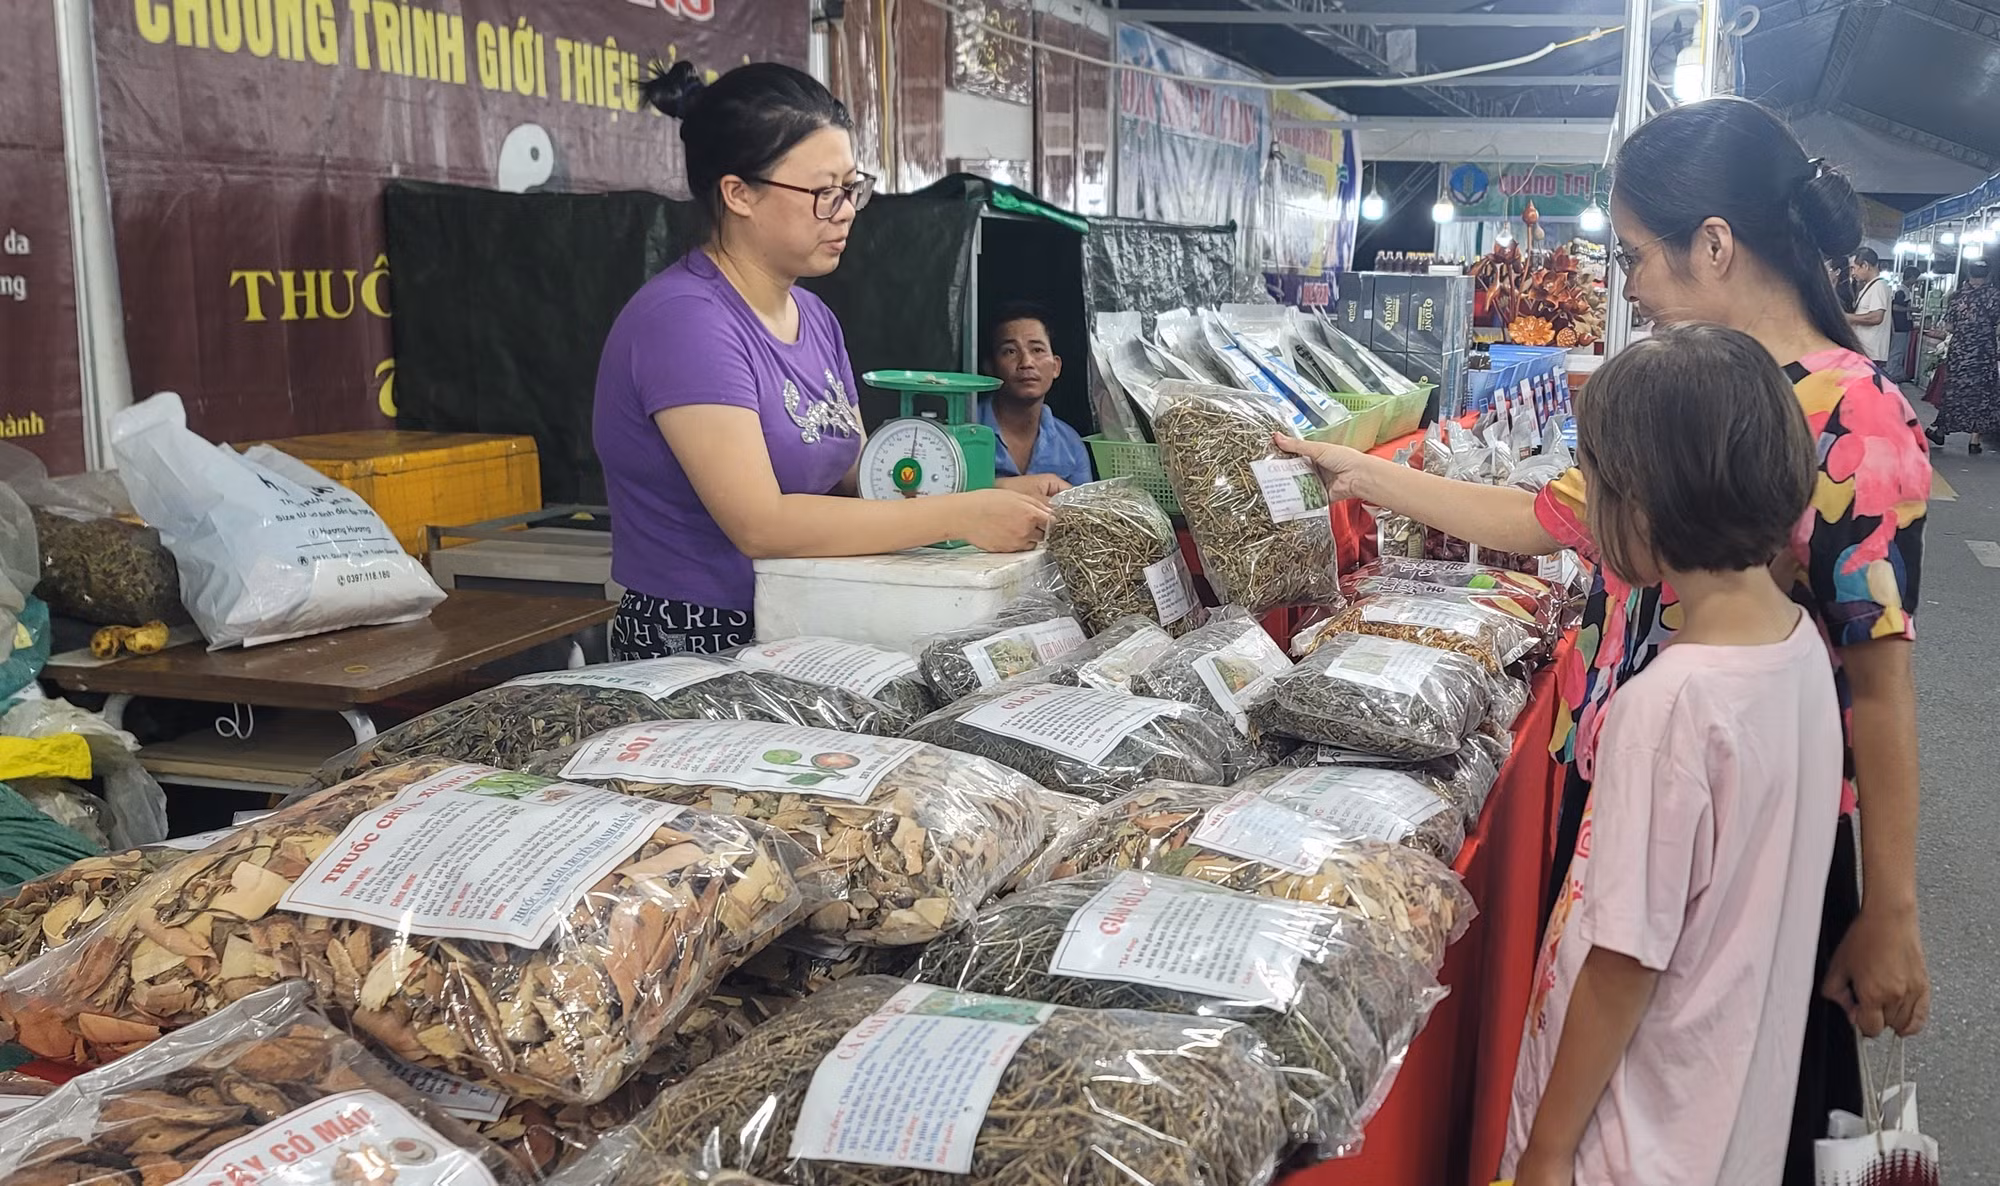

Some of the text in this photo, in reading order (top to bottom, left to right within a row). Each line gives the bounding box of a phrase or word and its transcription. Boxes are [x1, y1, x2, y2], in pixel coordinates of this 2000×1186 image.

[476, 16, 547, 98] GIỚI
[556, 36, 640, 122] THIỆU
[4, 228, 30, 255] da
[321, 832, 381, 884] THUỐC
[503, 896, 538, 922] THUỐC
[548, 866, 569, 878] GIA
[267, 1128, 317, 1165] CỎ
